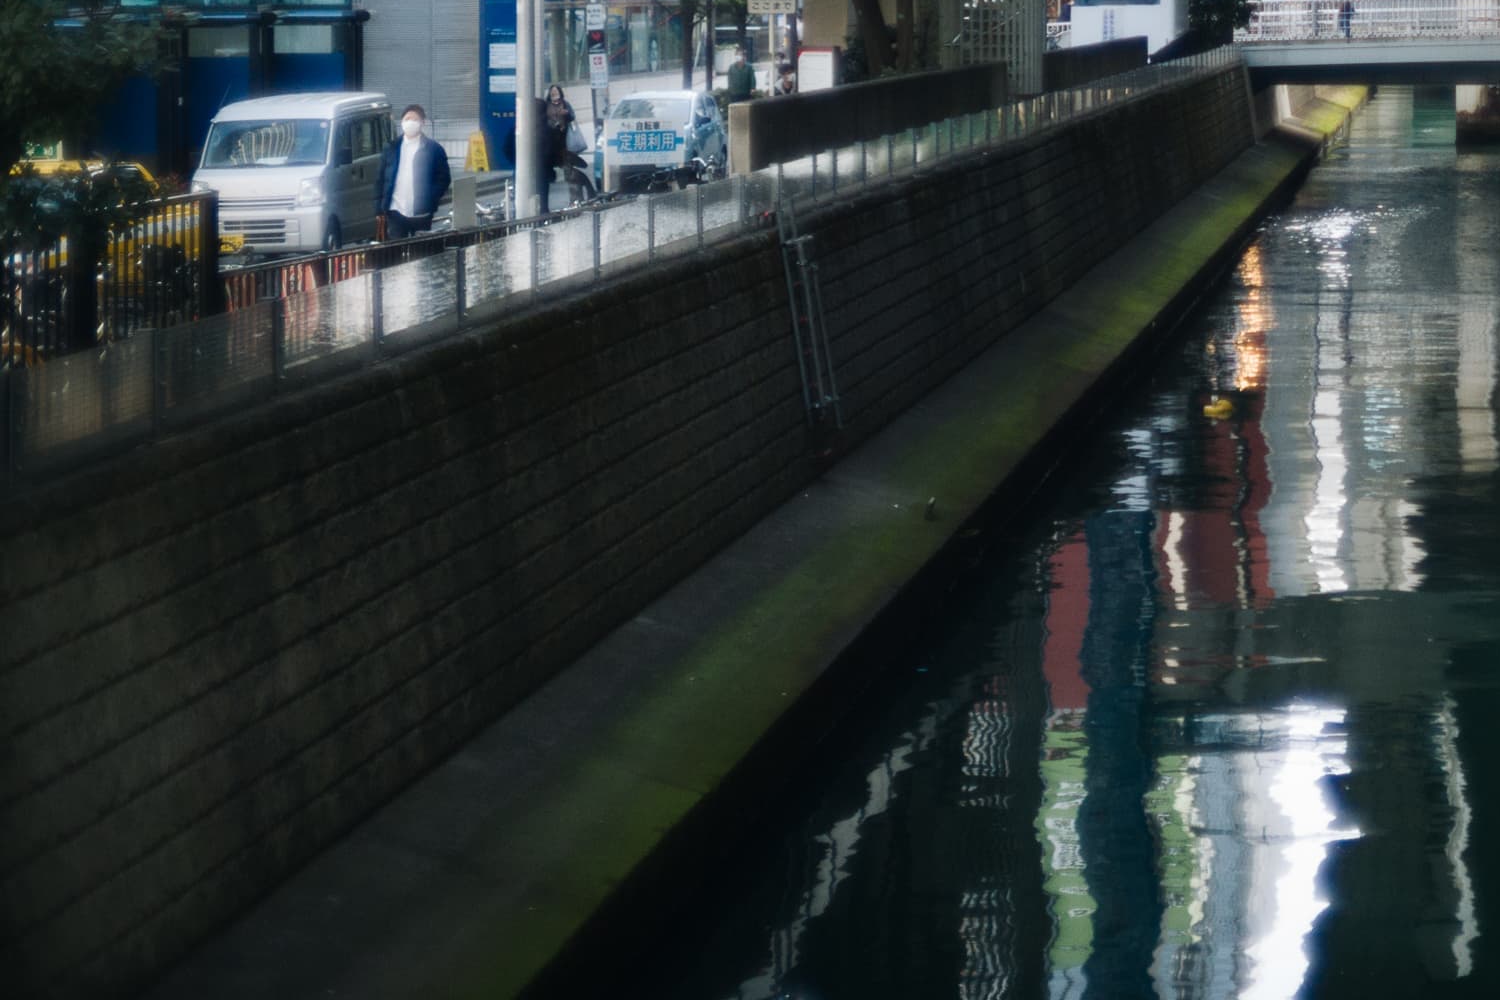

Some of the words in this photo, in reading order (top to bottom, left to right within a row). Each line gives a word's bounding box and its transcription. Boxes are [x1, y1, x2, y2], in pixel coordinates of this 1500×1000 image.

[751, 2, 792, 10] ここまで
[619, 133, 674, 151] 定期利用
